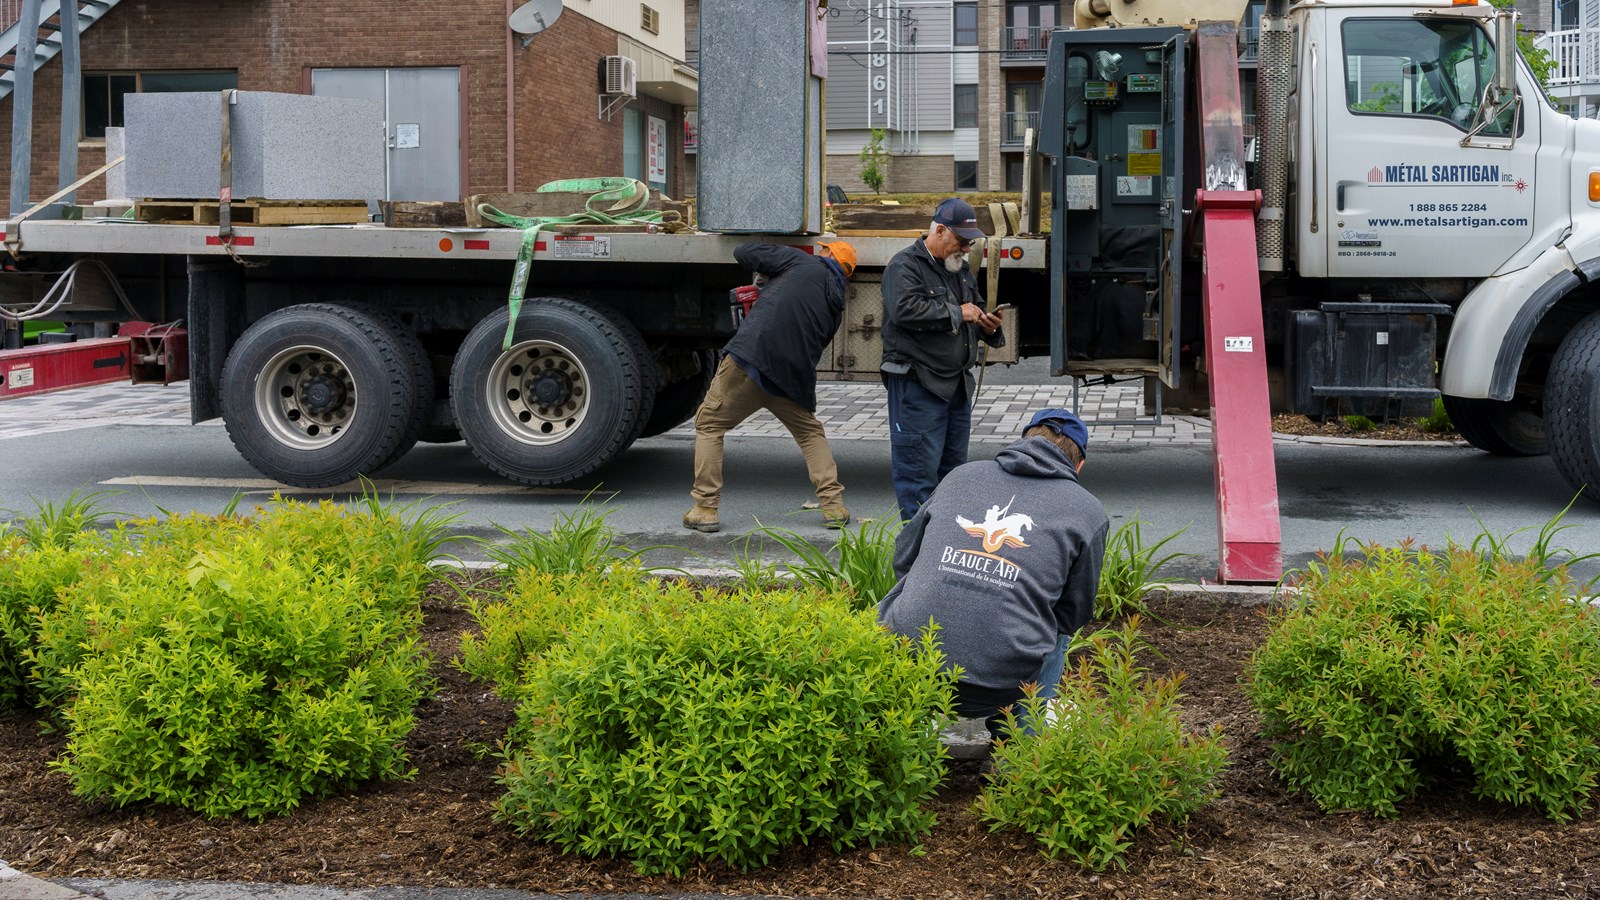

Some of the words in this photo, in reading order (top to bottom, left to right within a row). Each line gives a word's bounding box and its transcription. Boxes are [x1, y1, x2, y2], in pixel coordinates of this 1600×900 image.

[1385, 162, 1428, 183] MÉTAL
[1432, 165, 1499, 183] SARTIGAN
[1501, 172, 1515, 182] inc.
[1409, 203, 1414, 212] 1
[1416, 203, 1436, 212] 888
[1438, 203, 1458, 212] 865
[1460, 203, 1487, 212] 2284
[1367, 216, 1528, 229] www.metalsartigan.com
[941, 546, 992, 573] BEAUCE
[992, 558, 1022, 582] ART
[989, 576, 1015, 589] sculpture
